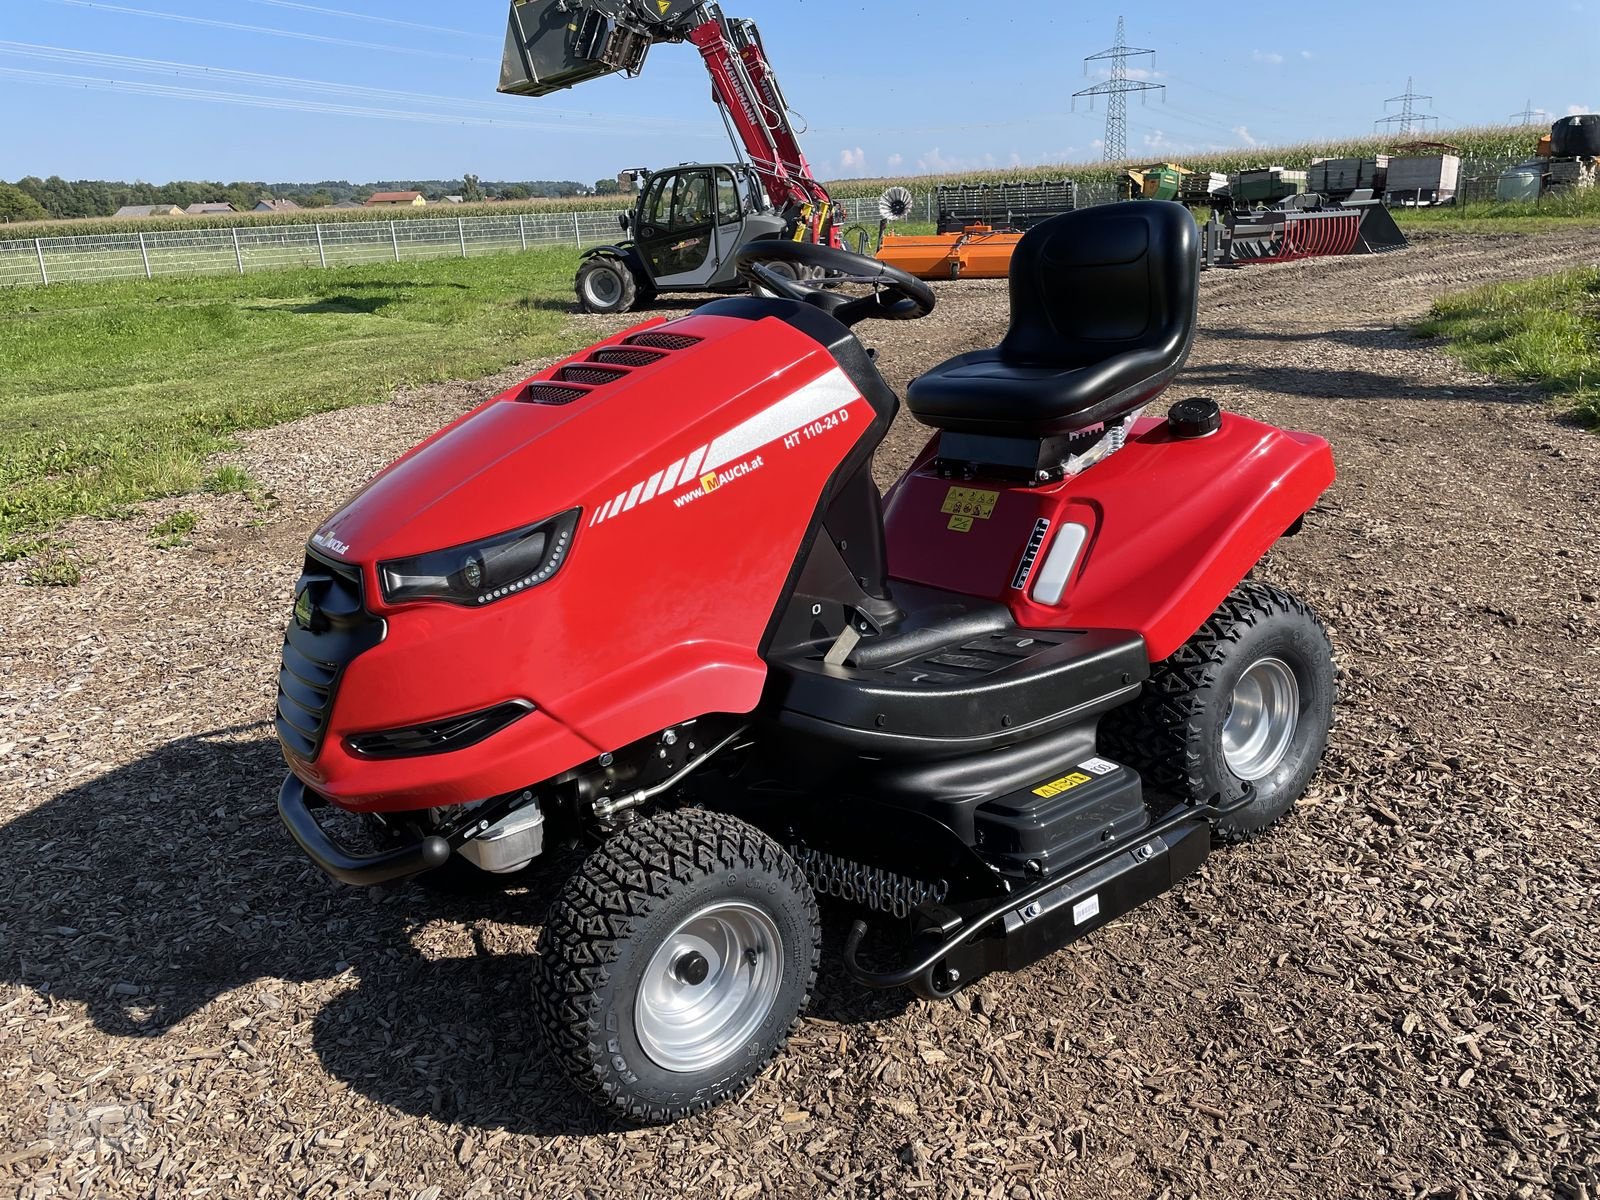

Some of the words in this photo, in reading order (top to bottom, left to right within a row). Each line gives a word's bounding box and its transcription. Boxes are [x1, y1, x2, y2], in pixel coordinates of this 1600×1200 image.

[723, 57, 758, 126] WEIDEMANN
[760, 76, 788, 135] WEIDEN
[784, 432, 801, 449] HT
[803, 416, 839, 440] 110-24
[839, 408, 849, 422] D
[673, 455, 764, 507] www.MAUCH.at
